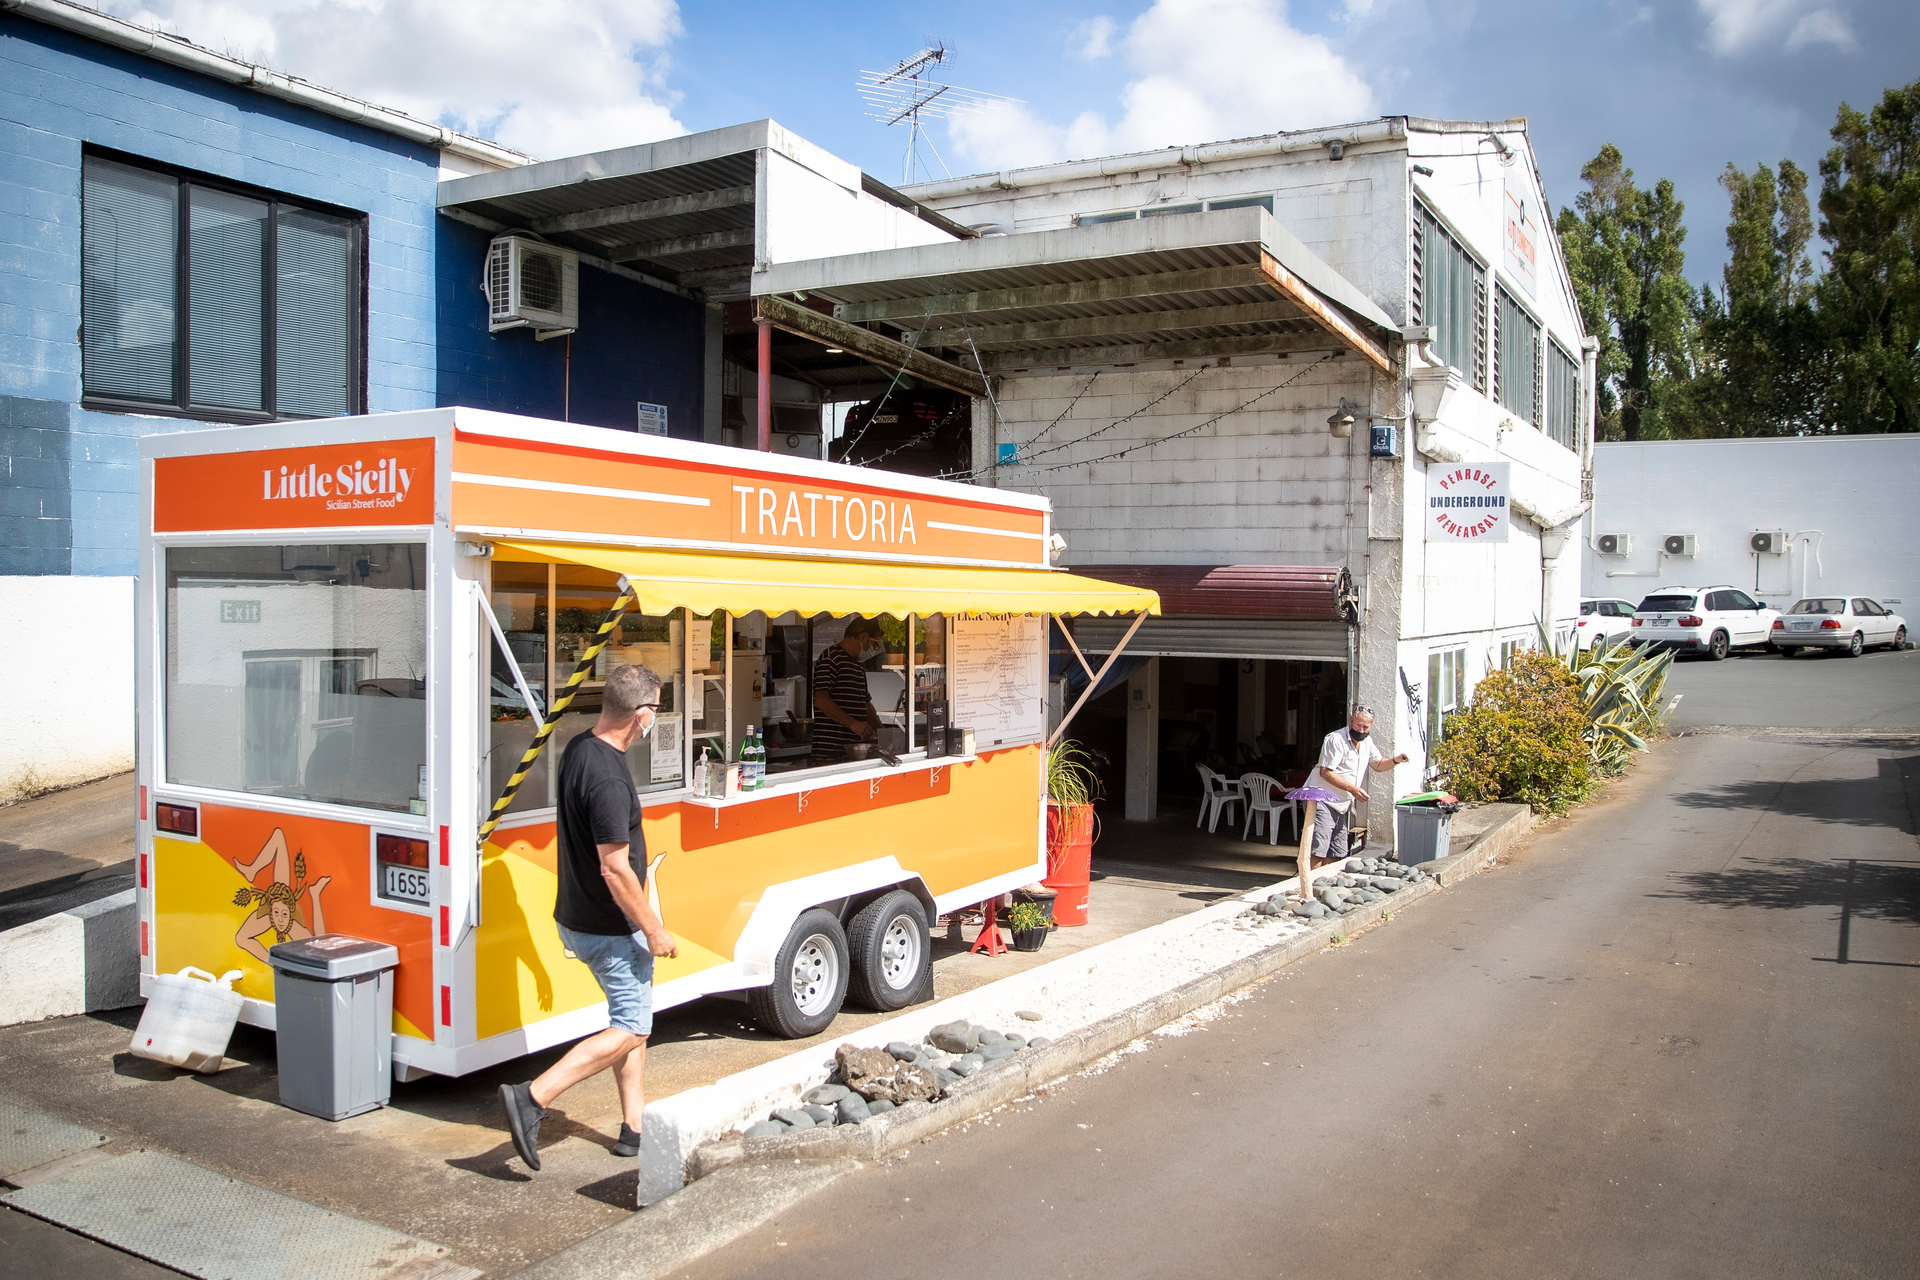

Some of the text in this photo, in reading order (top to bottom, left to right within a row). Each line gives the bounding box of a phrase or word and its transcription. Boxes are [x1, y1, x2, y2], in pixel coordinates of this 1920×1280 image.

[262, 458, 418, 503] Little Sicily
[1439, 468, 1497, 490] PENROSE
[326, 497, 395, 511] Sicilian Street Food
[1430, 495, 1506, 508] UNDERGROUND
[732, 485, 917, 545] TRATTORIA
[1436, 513, 1498, 538] REHEARSAL
[222, 602, 260, 622] Exit
[390, 870, 431, 897] 16S5
